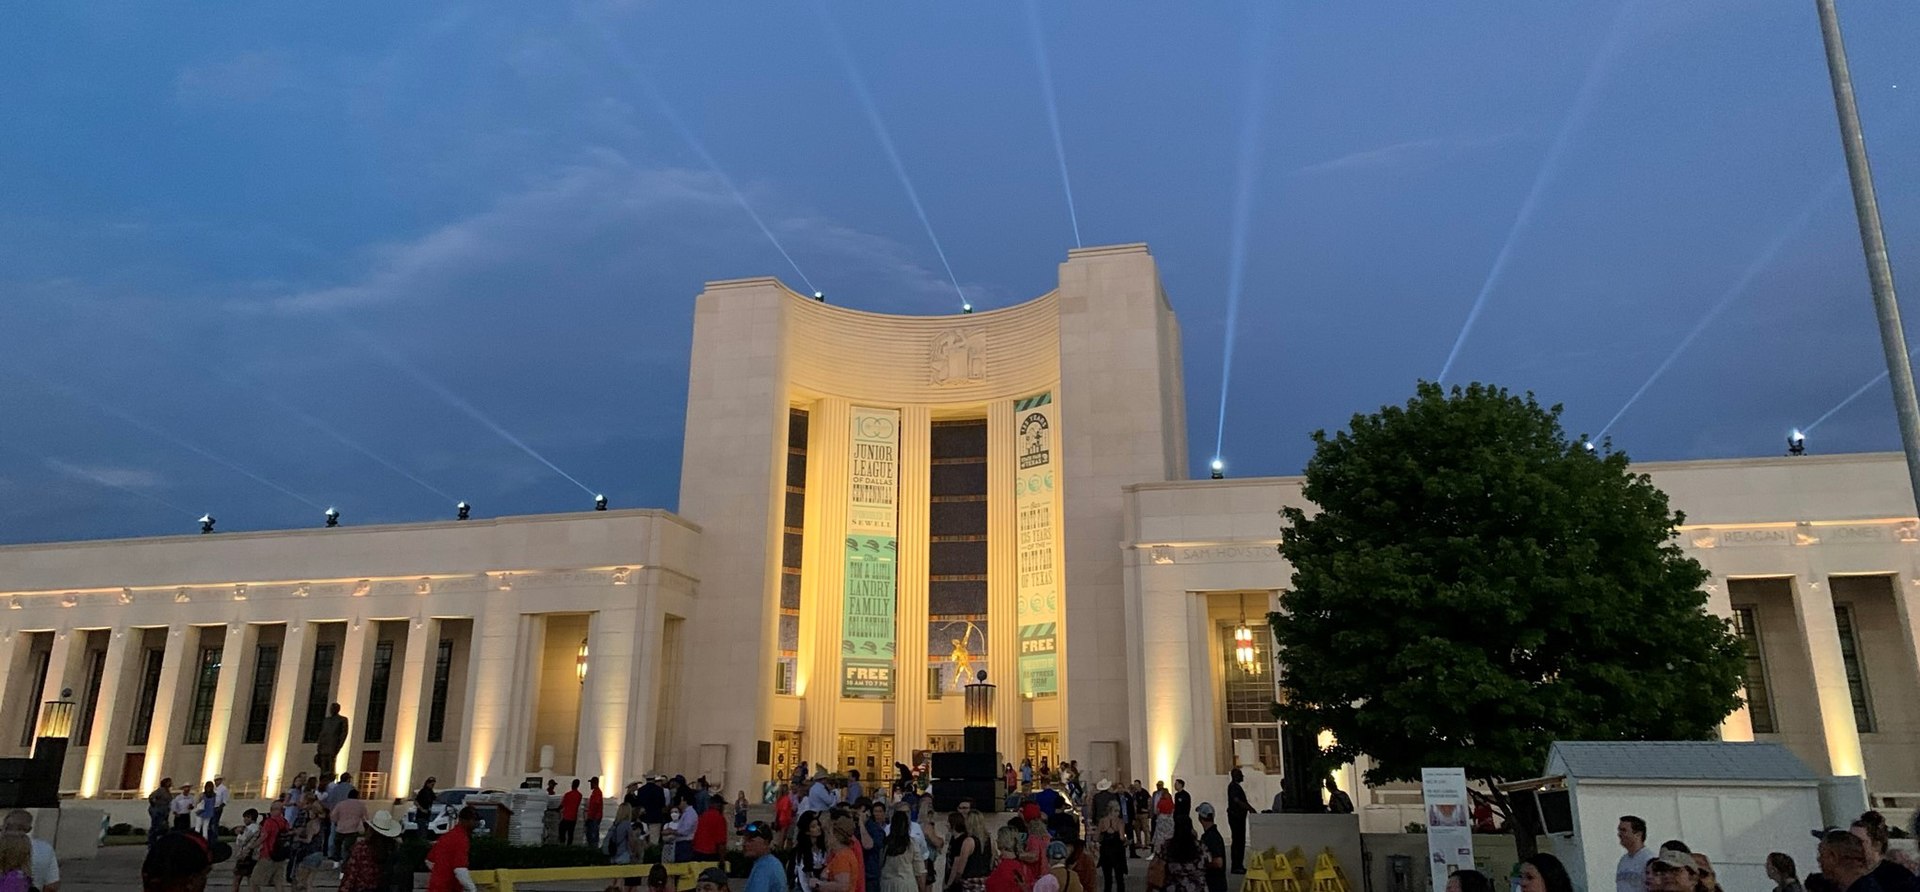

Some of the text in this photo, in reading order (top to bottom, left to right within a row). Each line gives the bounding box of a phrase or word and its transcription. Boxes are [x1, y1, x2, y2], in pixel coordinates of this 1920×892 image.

[856, 416, 893, 438] 100
[1029, 414, 1047, 428] YEARS
[854, 444, 893, 461] JUNIOR
[853, 460, 893, 478] LEAGUE
[1025, 458, 1042, 467] TEXAS
[853, 484, 893, 504] CENTENNIAL
[852, 519, 891, 527] SEWELL
[1032, 527, 1052, 543] YEARS
[1724, 531, 1785, 542] REAGAN
[1833, 527, 1881, 538] JONES
[1035, 541, 1046, 549] THE
[1183, 549, 1210, 559] SAM
[1021, 570, 1053, 588] OF TEXAS
[849, 579, 890, 597] LANDRY
[849, 597, 890, 616] FAMILY
[1022, 638, 1054, 653] FREE
[847, 667, 889, 680] FREE
